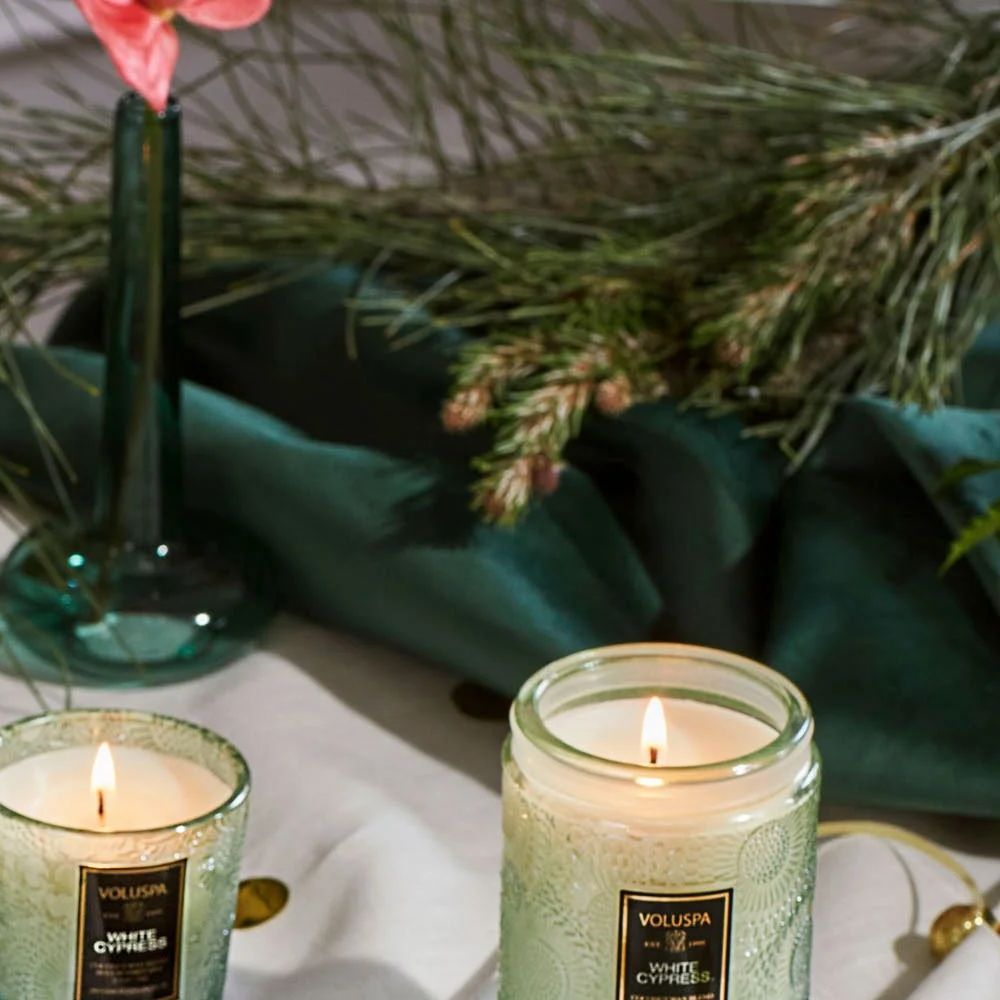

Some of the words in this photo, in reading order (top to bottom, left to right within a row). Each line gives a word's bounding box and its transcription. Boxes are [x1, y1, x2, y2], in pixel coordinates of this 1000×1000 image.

[98, 883, 167, 900] VOLUSPA
[639, 912, 711, 928] VOLUSPA
[106, 928, 158, 943] WHITE
[649, 961, 699, 974] WHITE
[636, 971, 711, 985] CYPRESS
